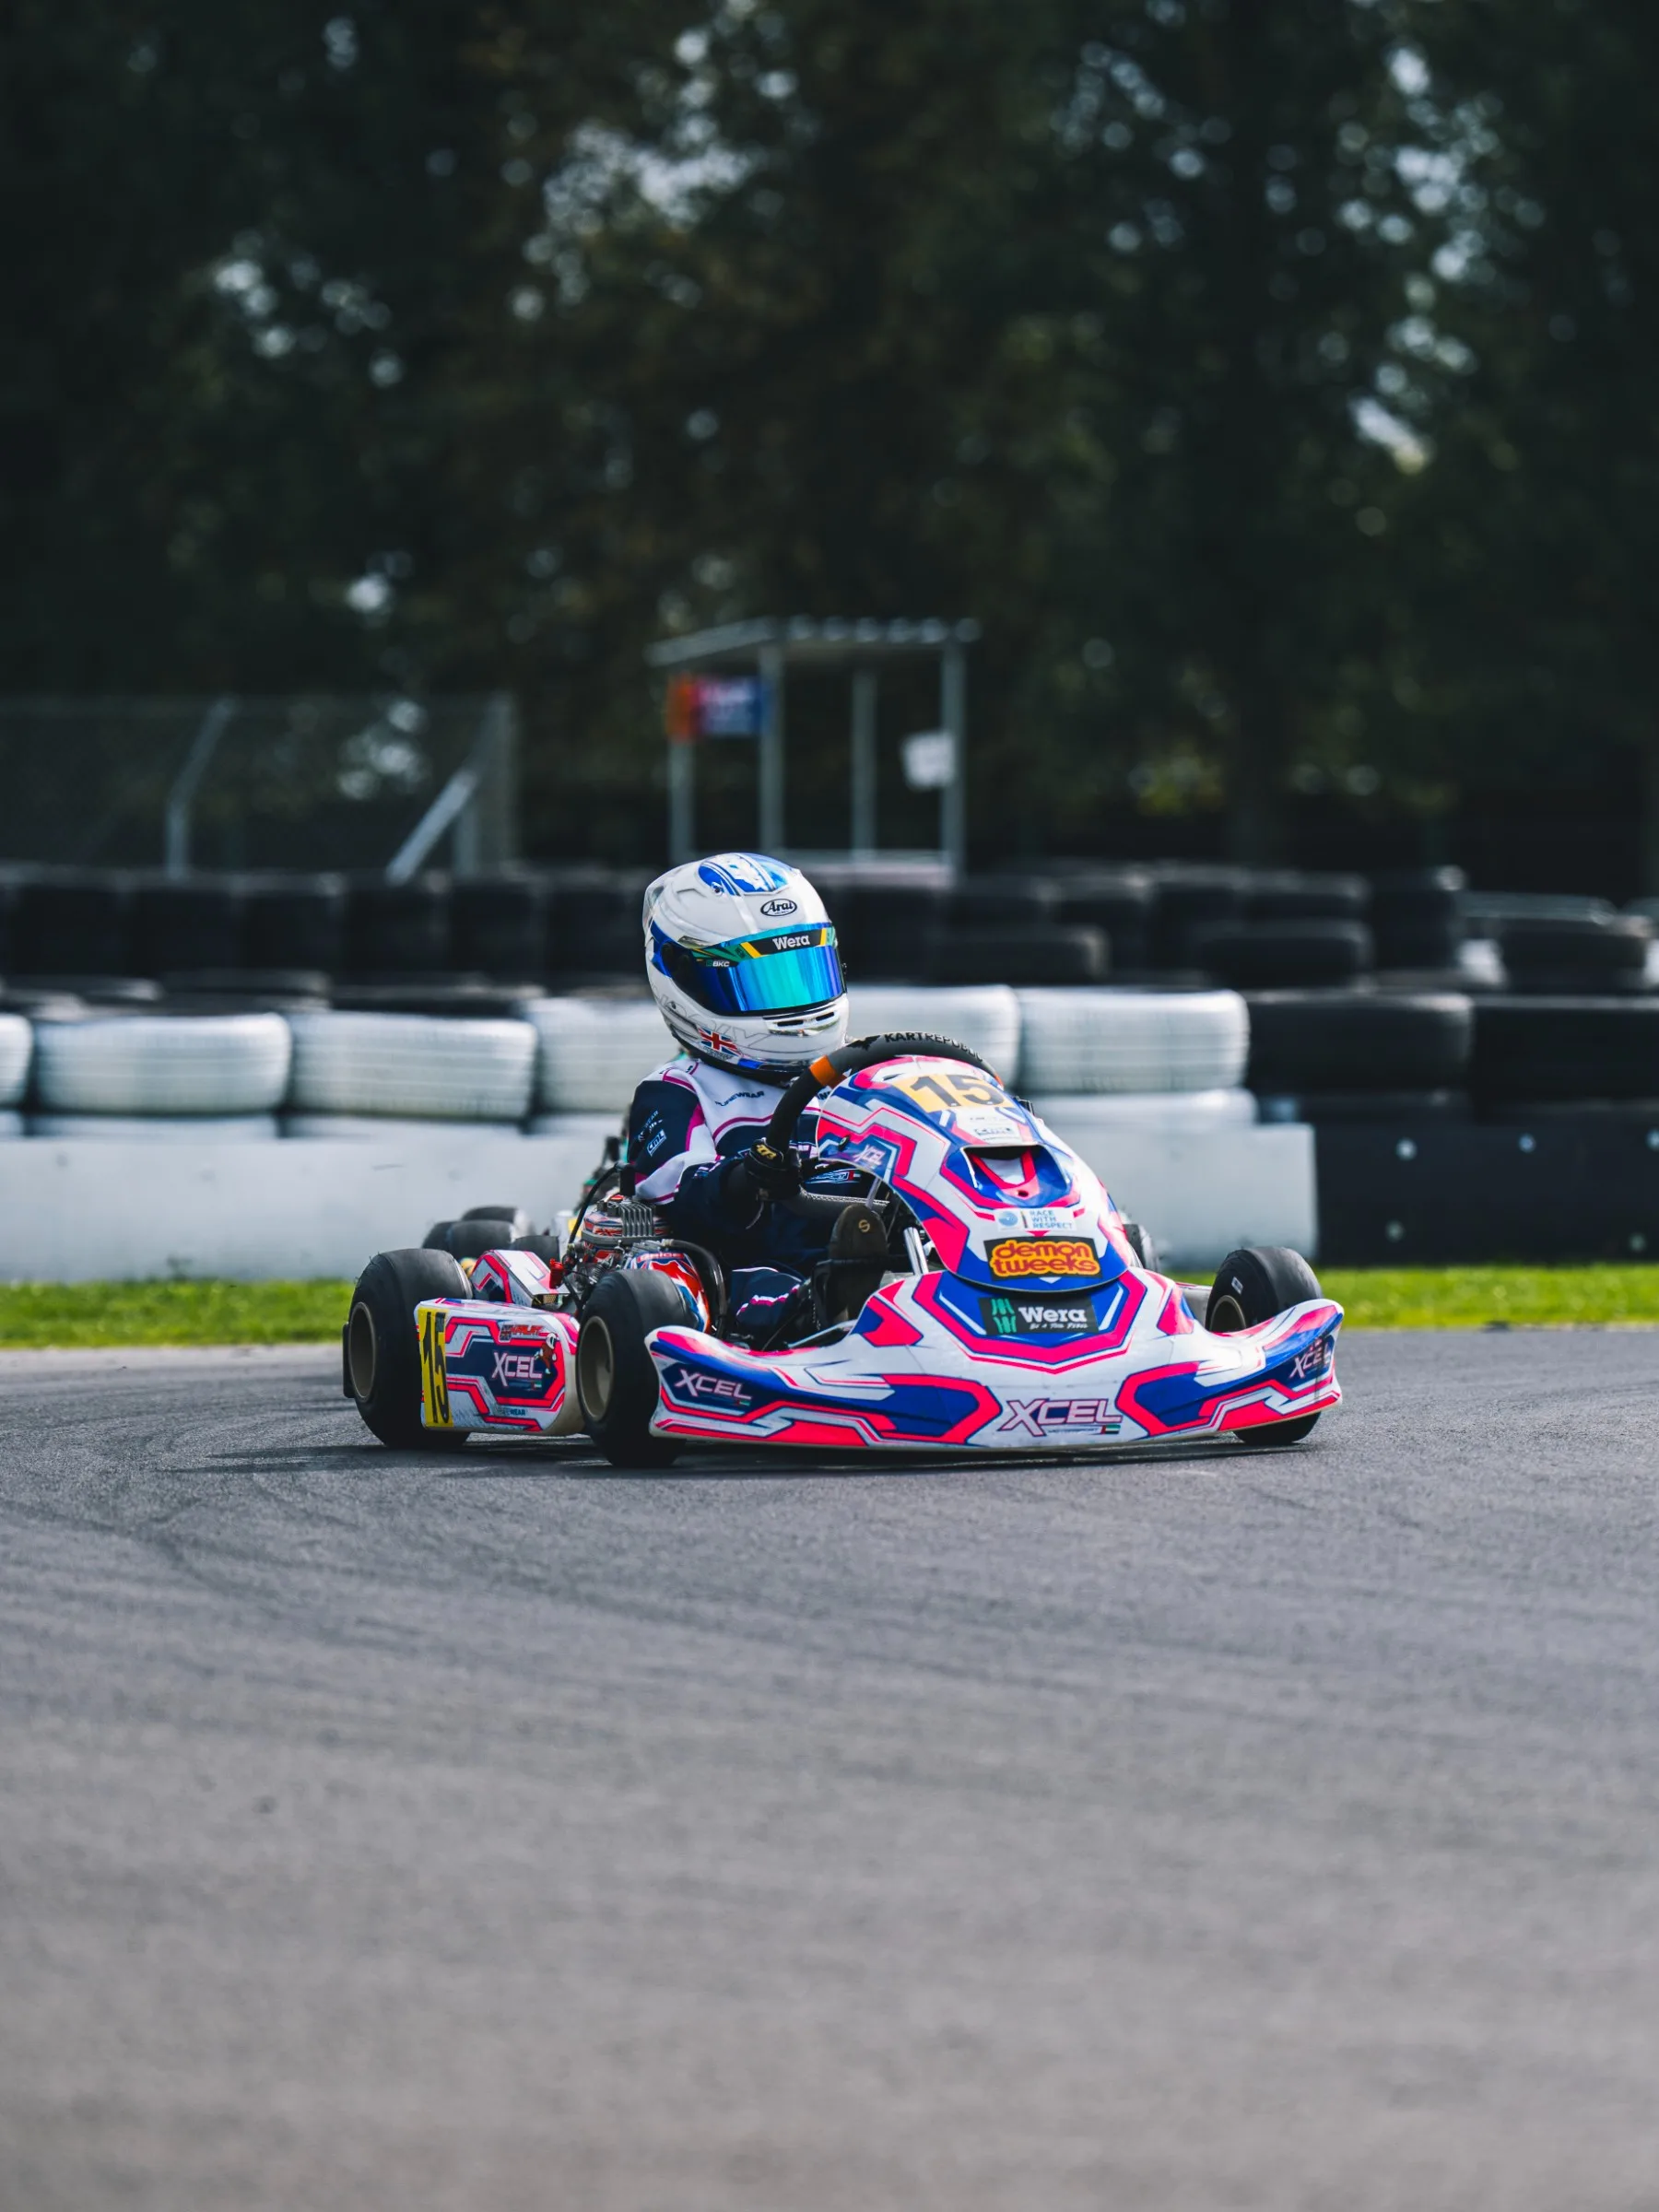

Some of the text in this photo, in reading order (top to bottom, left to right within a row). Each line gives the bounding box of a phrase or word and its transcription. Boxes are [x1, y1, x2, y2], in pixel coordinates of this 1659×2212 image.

[768, 900, 794, 913] Arai
[772, 935, 811, 950] Wera
[910, 1074, 1006, 1107] 15
[994, 1242, 1091, 1258] demon
[994, 1254, 1097, 1274] tweeks
[1018, 1306, 1088, 1324] Wera
[423, 1312, 450, 1423] 15
[491, 1352, 542, 1387] XCEL
[674, 1369, 752, 1397] XCEL
[996, 1398, 1123, 1437] XCEL
